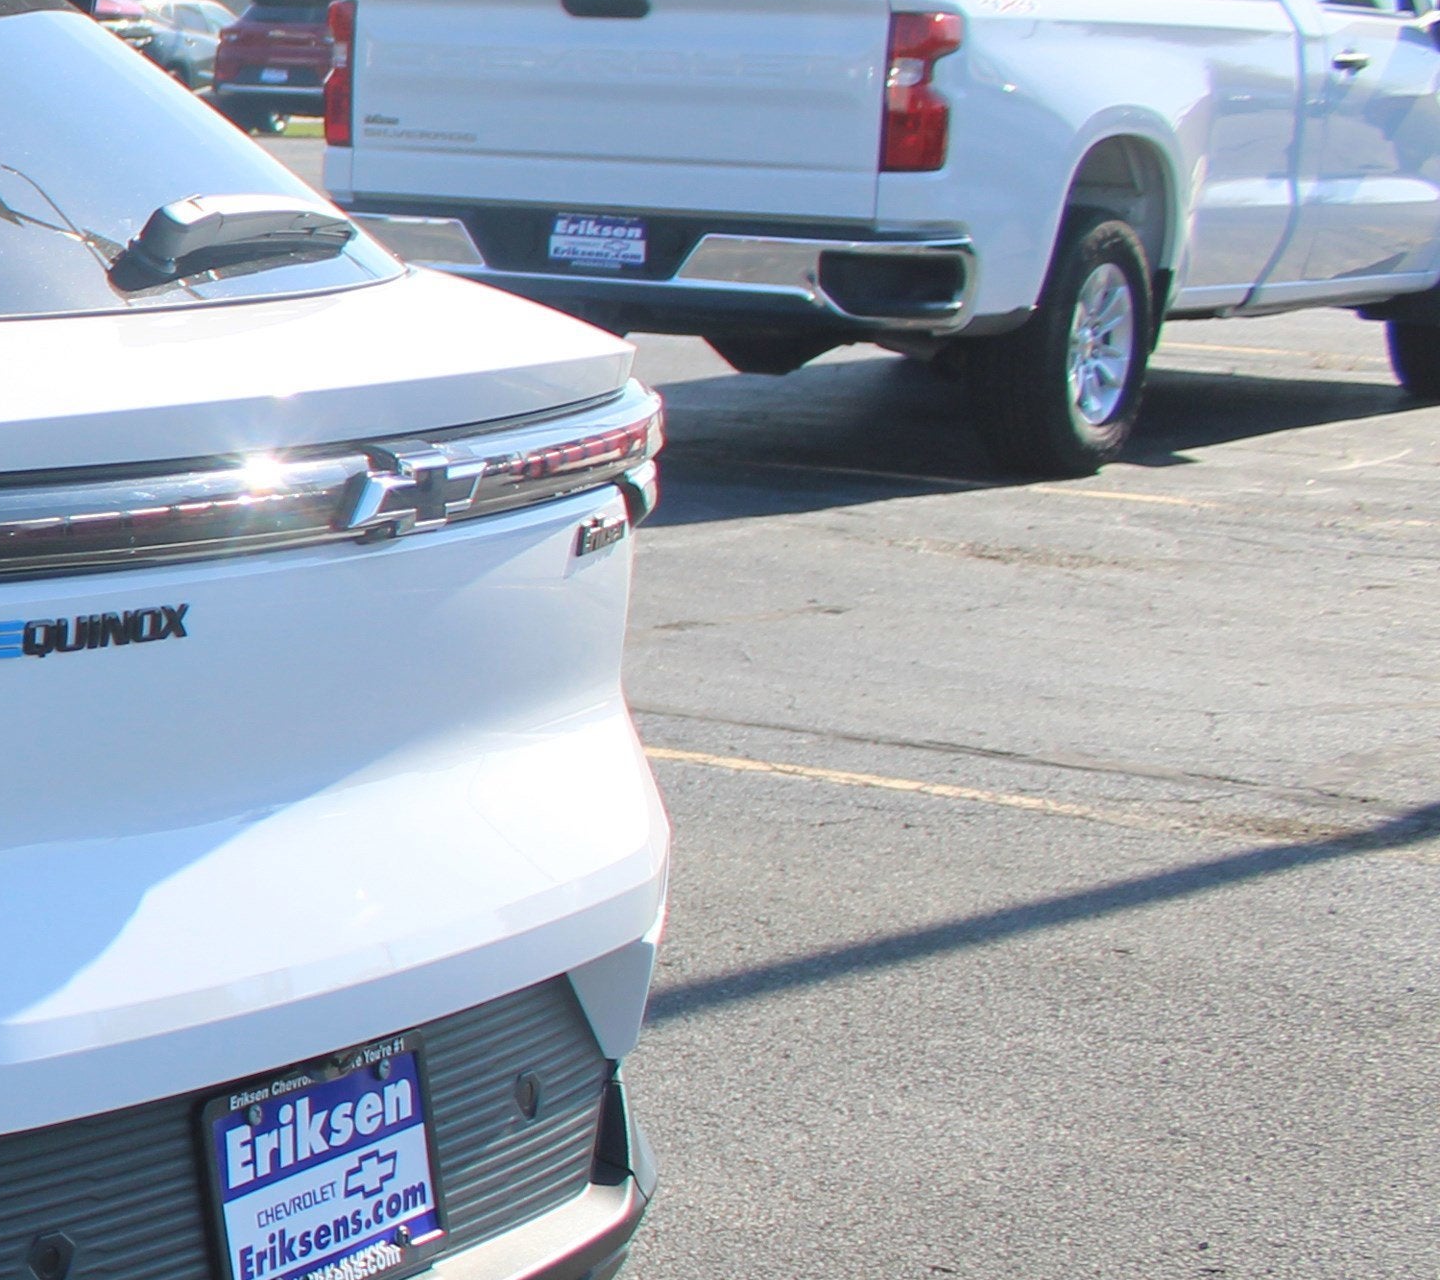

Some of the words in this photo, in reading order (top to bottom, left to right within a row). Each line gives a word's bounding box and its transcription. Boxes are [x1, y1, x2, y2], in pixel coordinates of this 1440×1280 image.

[554, 219, 642, 239] Eriksen
[230, 1087, 268, 1111] Eriksen
[225, 1078, 413, 1189] Eriksen
[257, 1180, 338, 1228] CHEVROLET
